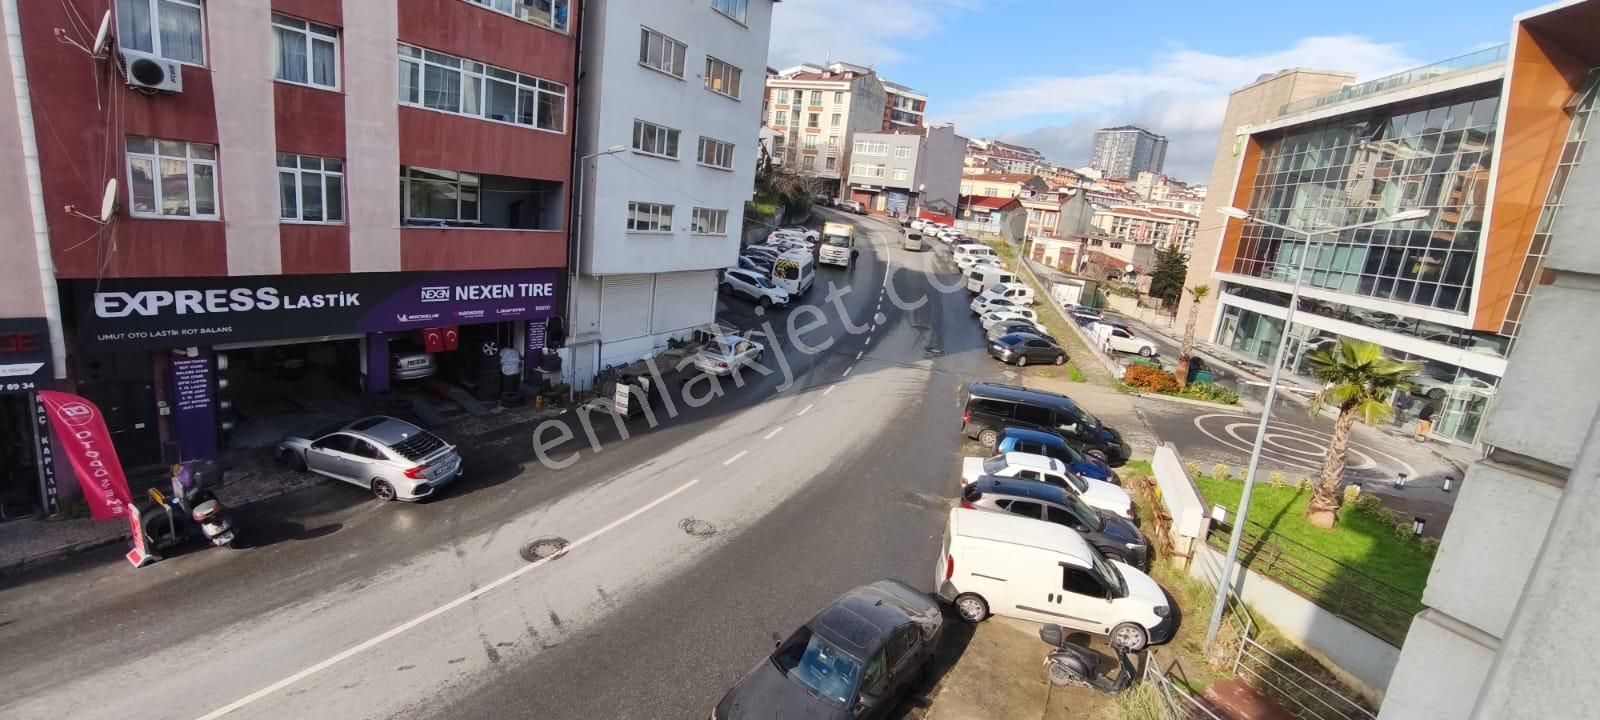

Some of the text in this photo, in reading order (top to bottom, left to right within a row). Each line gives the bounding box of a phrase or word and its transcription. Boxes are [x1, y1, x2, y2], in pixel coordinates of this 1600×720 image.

[455, 283, 553, 301] NEXEN TIRE
[94, 287, 361, 318] EXPRESS LASTİK
[97, 326, 233, 341] UMUT OTO LASTİK ROT BALANS
[22, 382, 34, 390] 34
[41, 436, 58, 507] KAPLAMA
